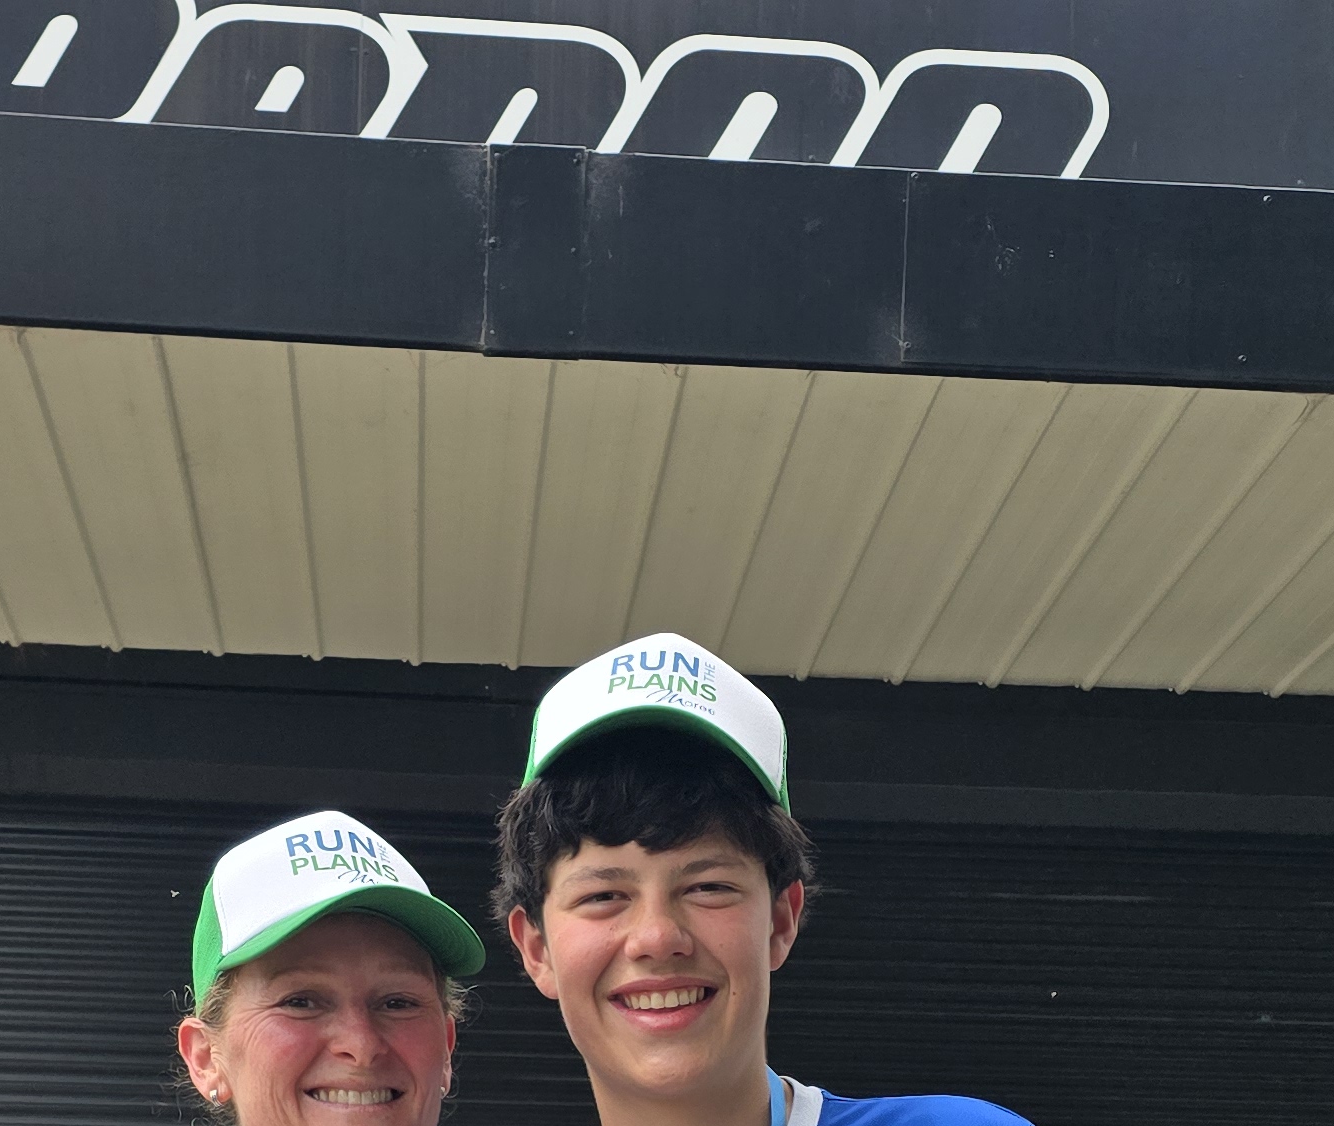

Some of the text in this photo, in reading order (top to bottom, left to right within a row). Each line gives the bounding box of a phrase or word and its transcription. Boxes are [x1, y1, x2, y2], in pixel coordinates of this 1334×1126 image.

[611, 651, 716, 683] RUN THE
[608, 673, 717, 702] PLAINS
[285, 830, 376, 858] RUN
[290, 854, 399, 882] PLAINS
